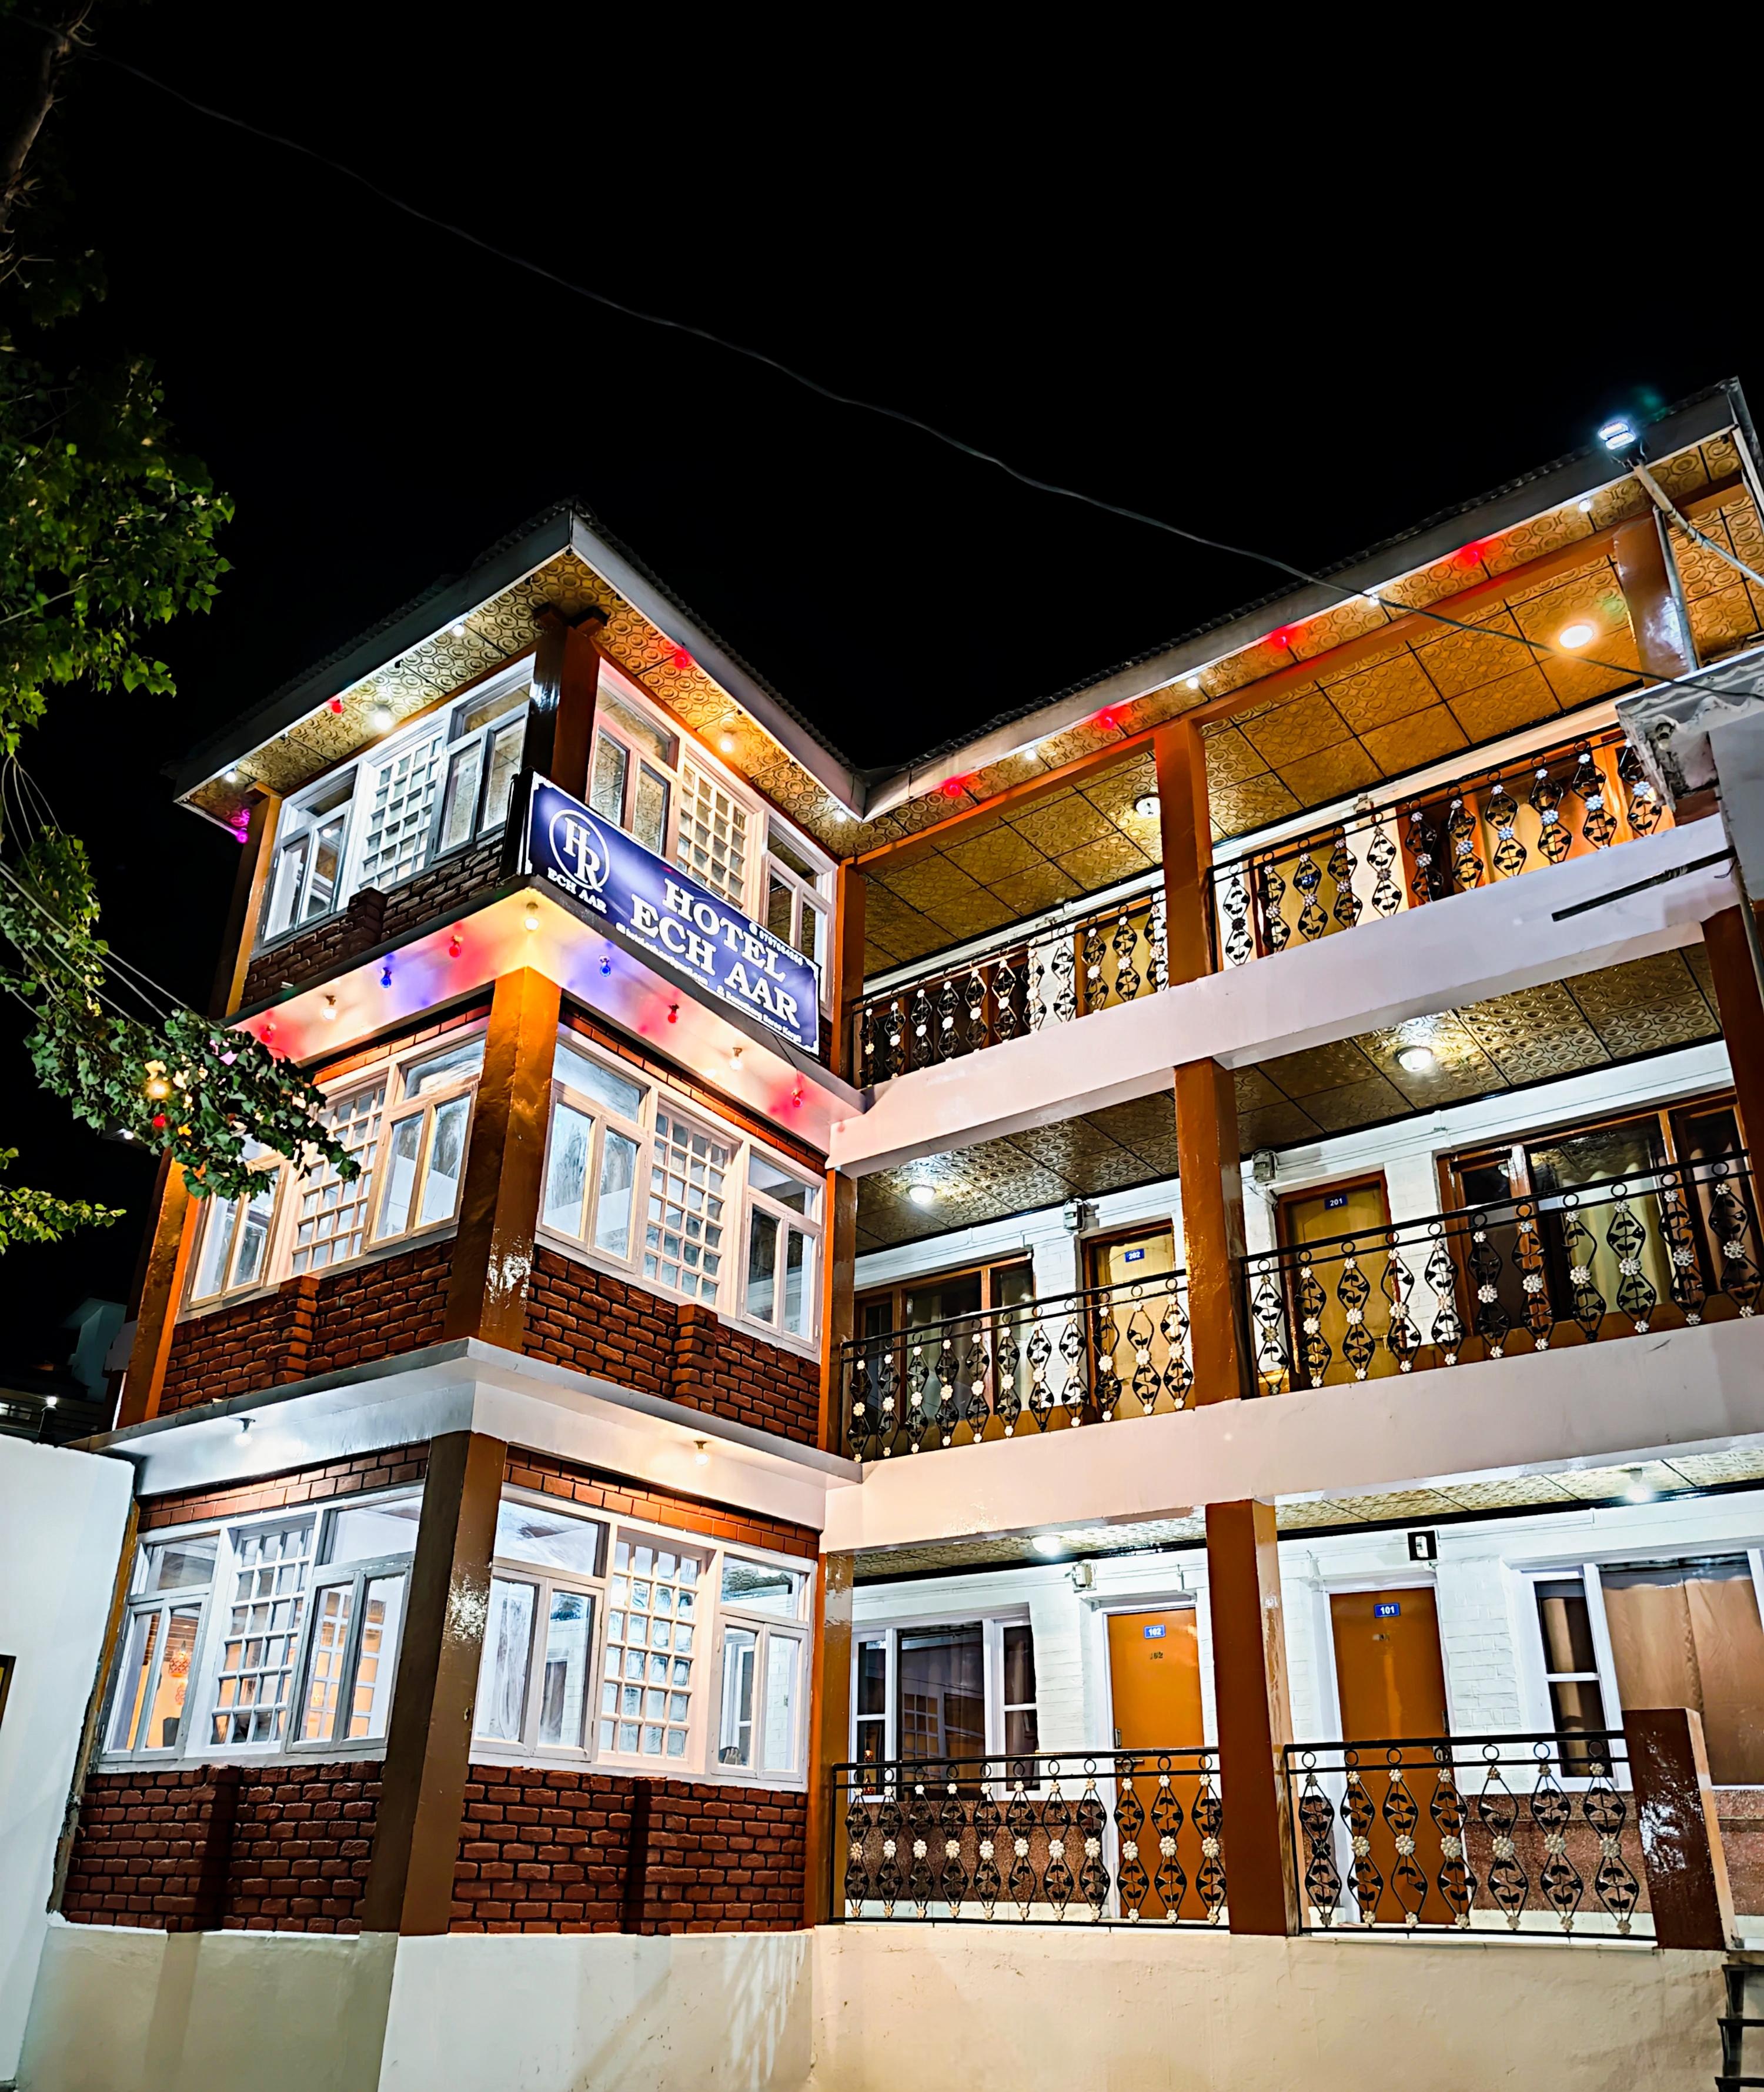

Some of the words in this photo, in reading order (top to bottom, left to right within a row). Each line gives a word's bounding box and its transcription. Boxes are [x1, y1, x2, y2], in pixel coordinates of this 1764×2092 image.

[547, 867, 576, 894] ECH
[579, 889, 607, 914] AAR
[662, 878, 786, 982] HOTEL
[630, 893, 716, 976] ECH
[724, 961, 800, 1028] AAR
[1329, 1198, 1342, 1207] 201
[1128, 1251, 1140, 1259] 202
[1380, 1606, 1395, 1615] 101
[1148, 1628, 1161, 1636] 102
